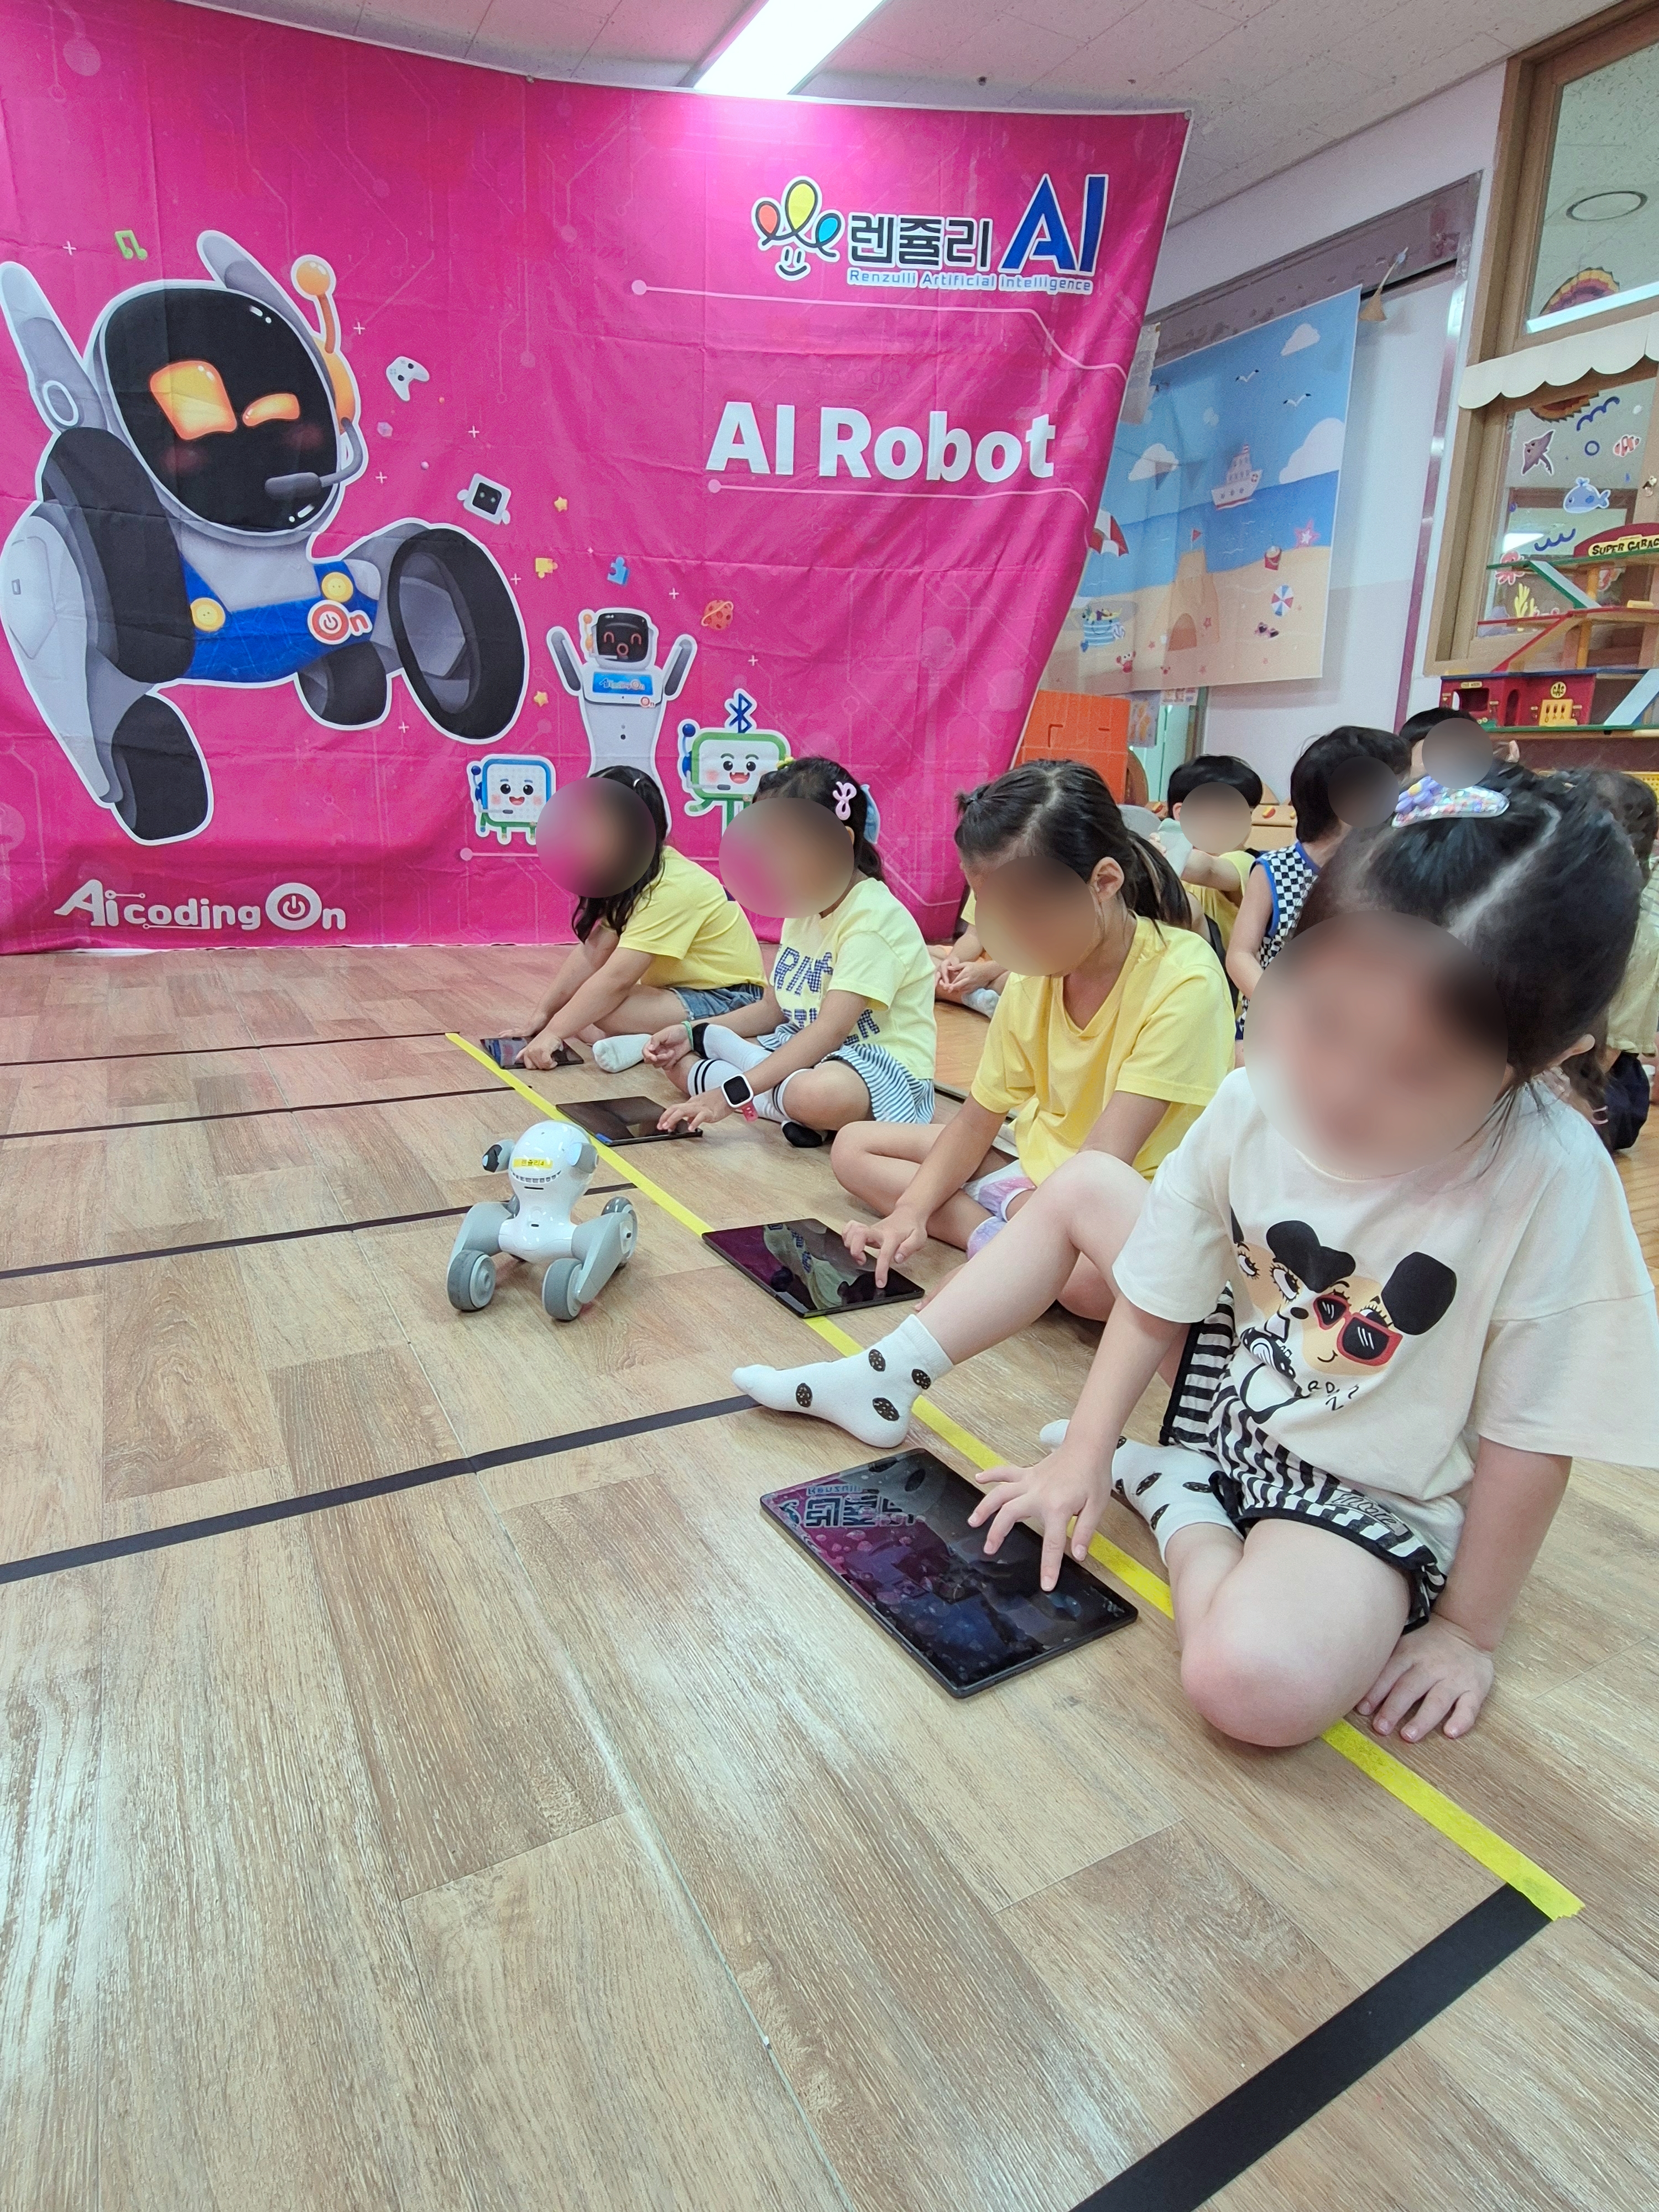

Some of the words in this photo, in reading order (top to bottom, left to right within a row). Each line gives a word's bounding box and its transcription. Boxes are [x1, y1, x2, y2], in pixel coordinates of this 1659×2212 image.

[850, 213, 991, 268] 렌쥴리
[999, 174, 1108, 275] AI
[850, 269, 916, 284] Renzulli
[922, 273, 995, 287] Artificial
[706, 401, 796, 476] AI
[819, 406, 1056, 483] Robot
[1592, 543, 1625, 555] SUPER
[1552, 684, 1564, 696] GAS
